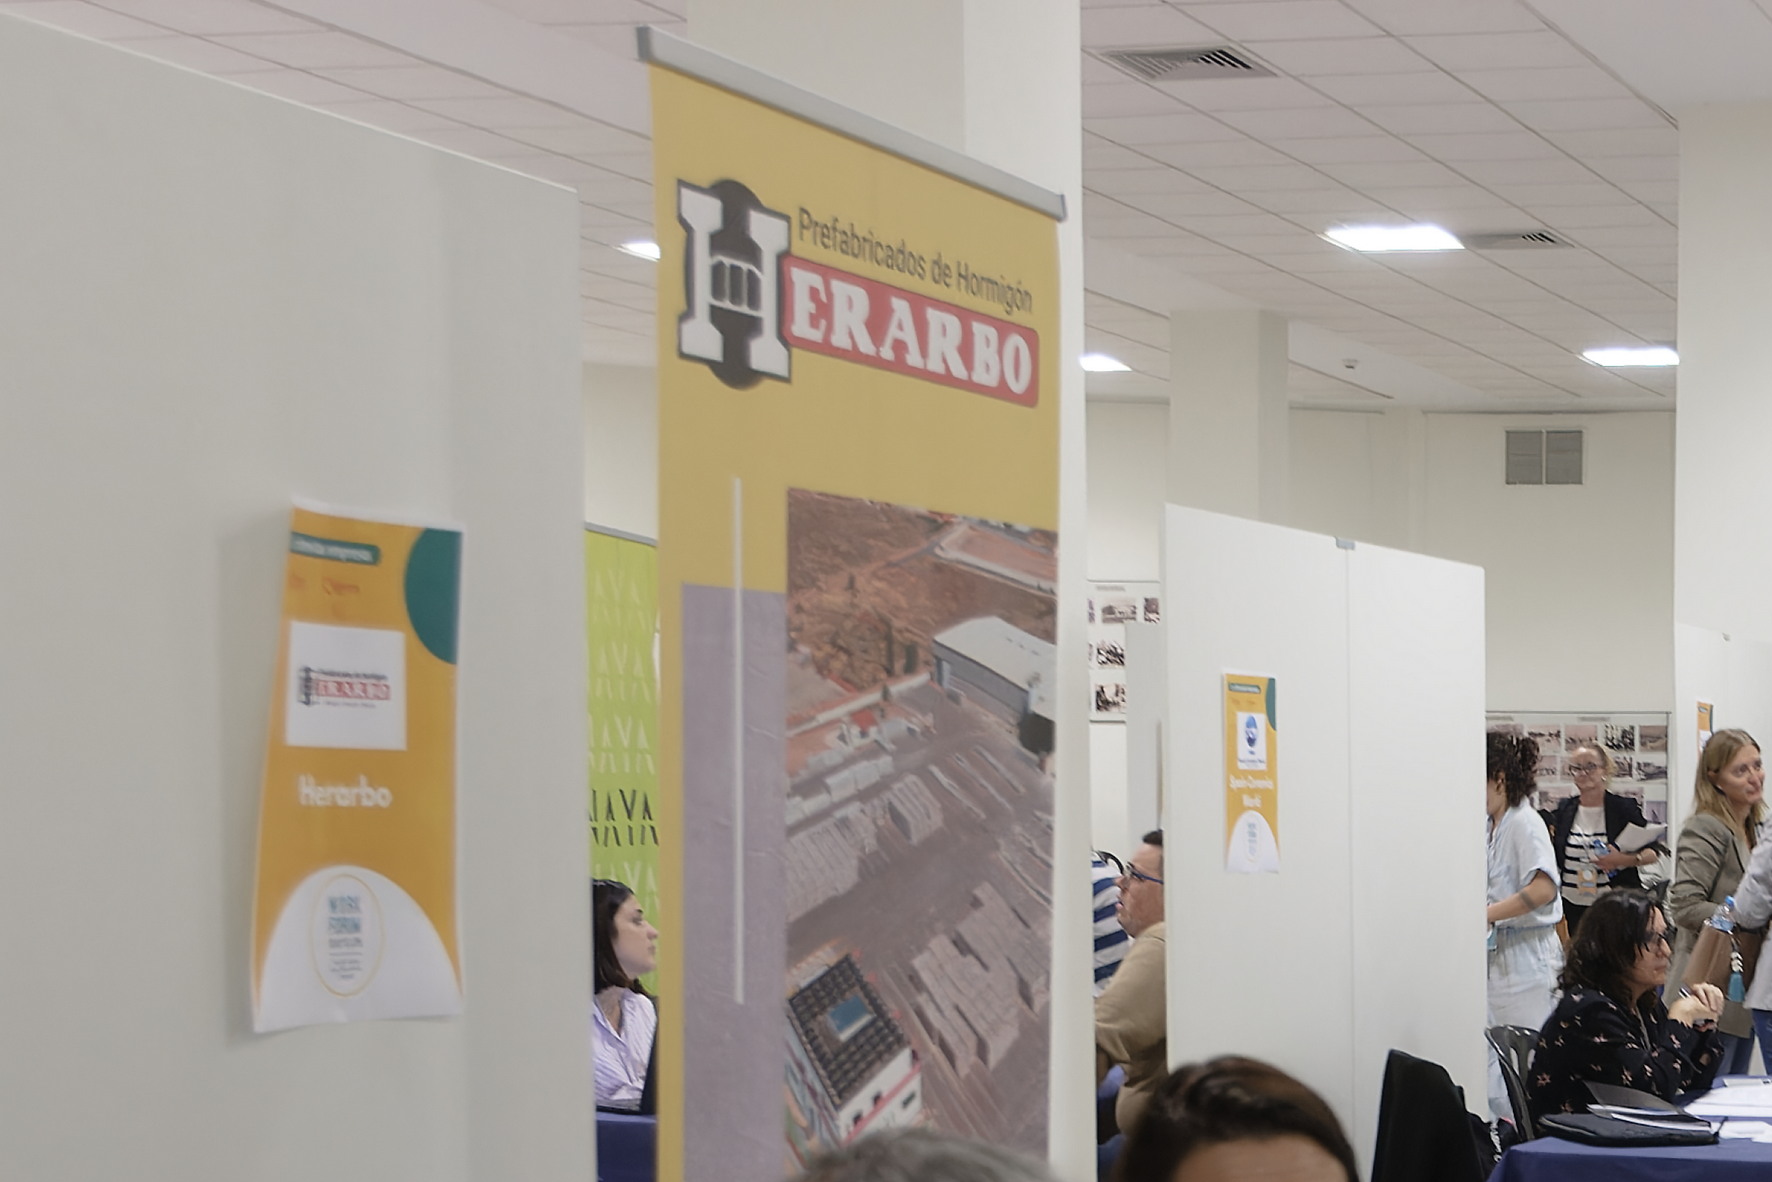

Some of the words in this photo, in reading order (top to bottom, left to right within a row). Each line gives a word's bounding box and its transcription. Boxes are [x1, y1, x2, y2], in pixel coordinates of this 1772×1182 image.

[798, 206, 926, 281] Prefabricados
[931, 252, 953, 288] de
[956, 260, 1033, 315] Hormigón
[298, 773, 393, 808] Herarbo
